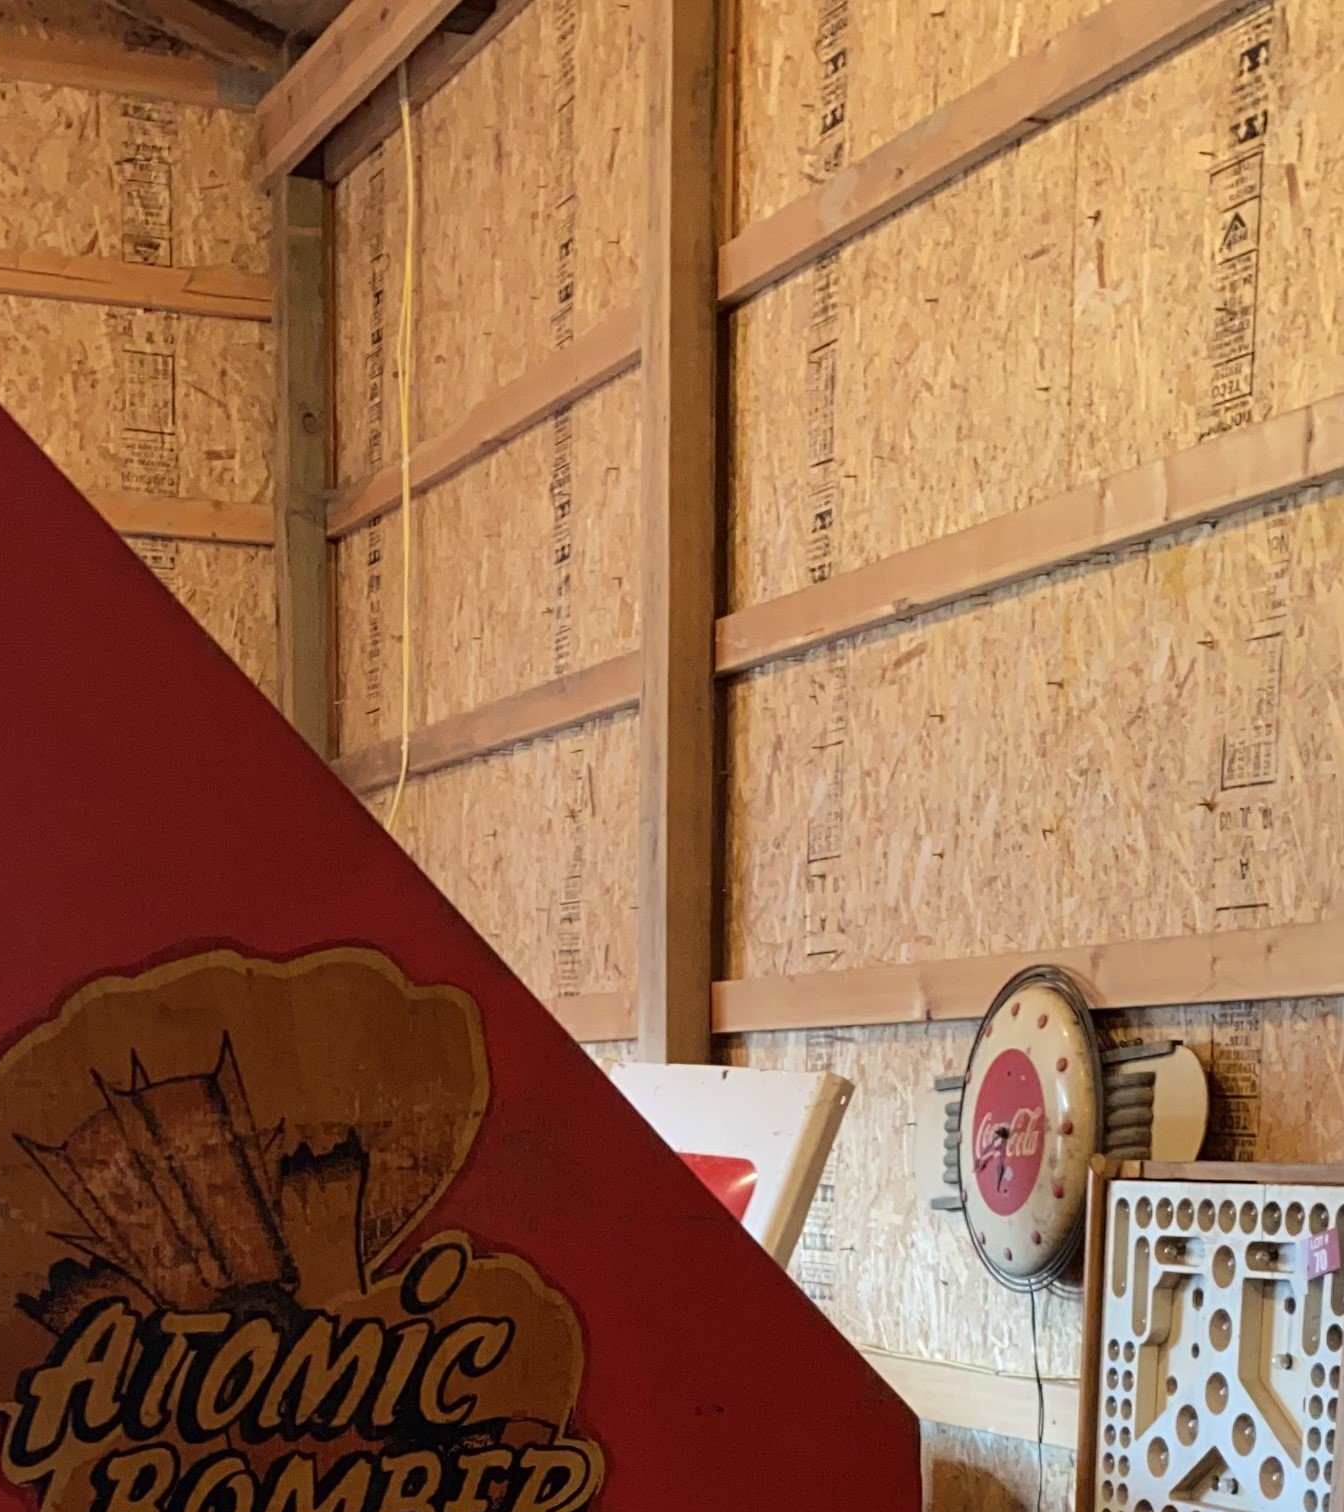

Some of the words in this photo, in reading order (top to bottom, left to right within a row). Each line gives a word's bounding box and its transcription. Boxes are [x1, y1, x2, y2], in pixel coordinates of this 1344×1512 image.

[1310, 1235, 1323, 1250] LOT
[1313, 1249, 1328, 1273] 70
[8, 1242, 517, 1465] ATOMIC
